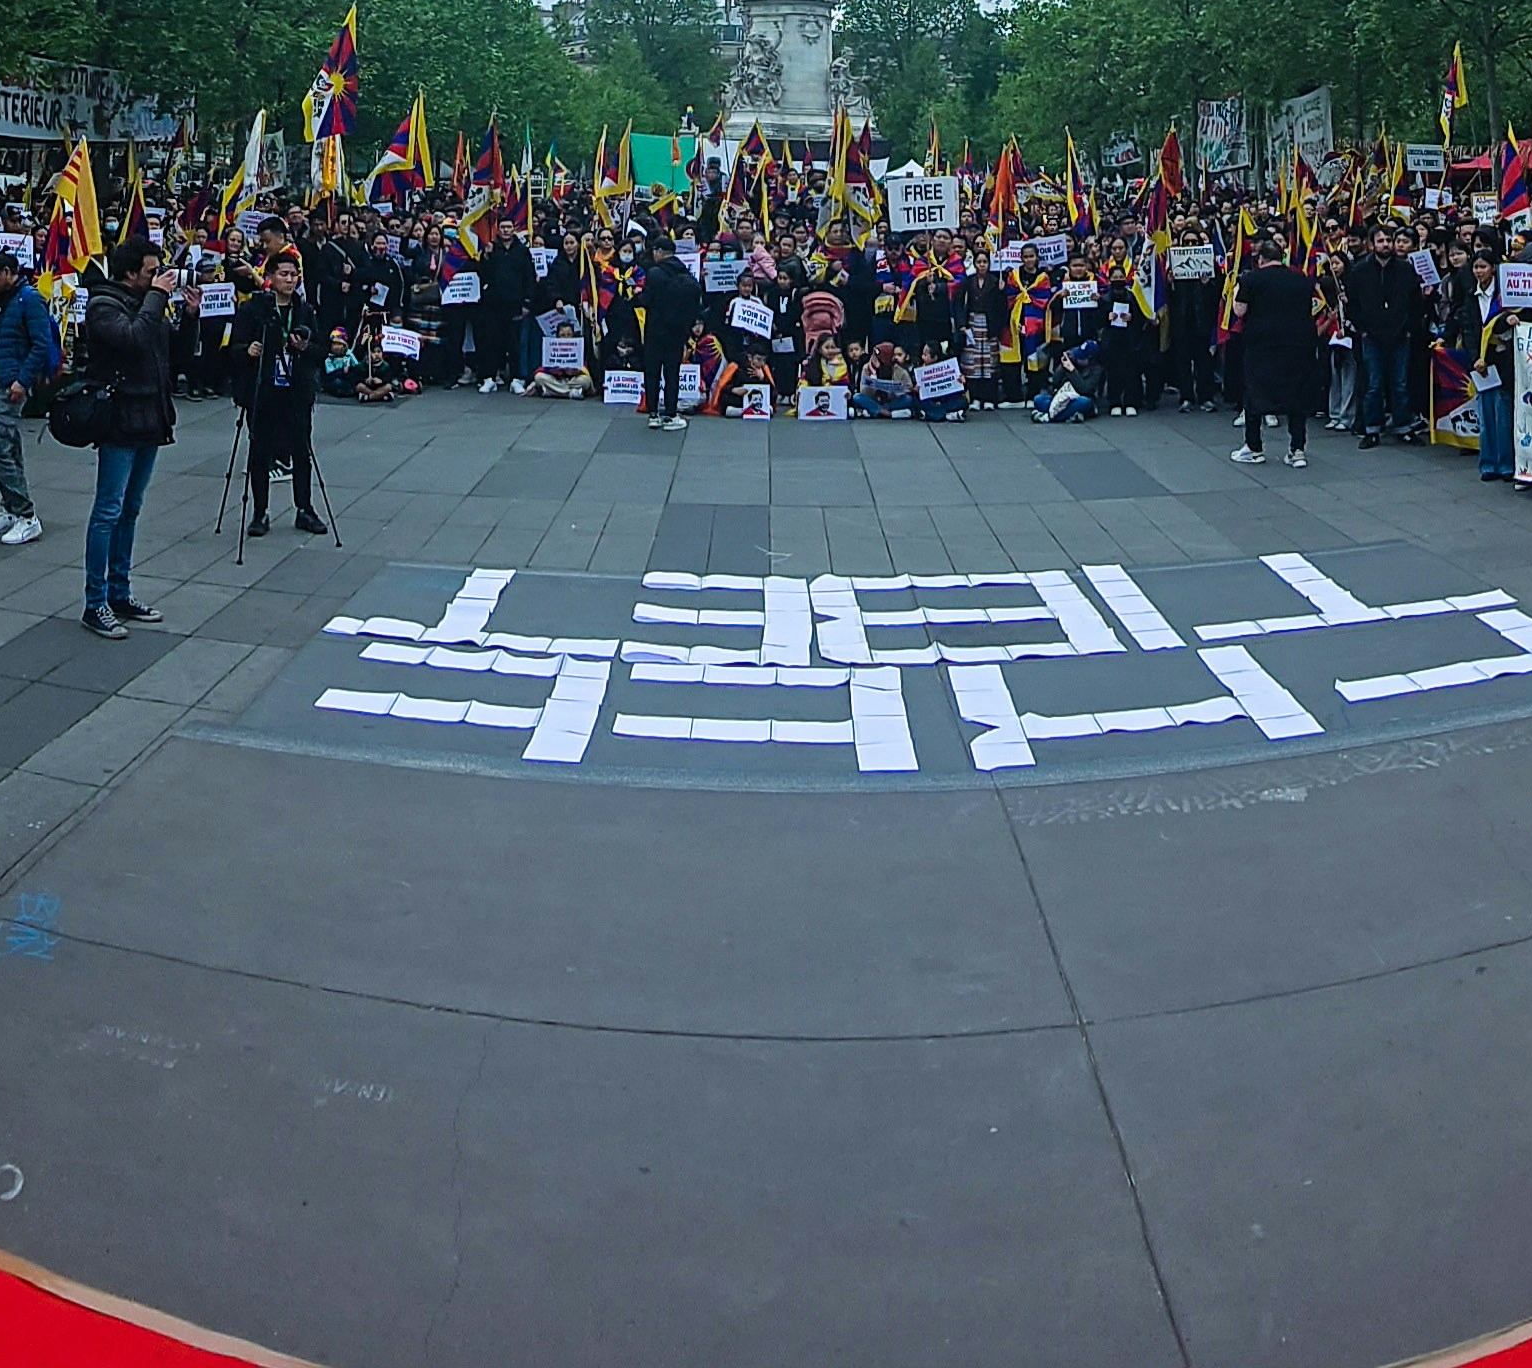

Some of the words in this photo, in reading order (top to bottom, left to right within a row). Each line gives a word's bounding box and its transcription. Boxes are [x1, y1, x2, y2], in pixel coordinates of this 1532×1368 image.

[904, 183, 943, 202] FREE
[902, 204, 946, 224] TIBET
[1506, 280, 1520, 289] AU
